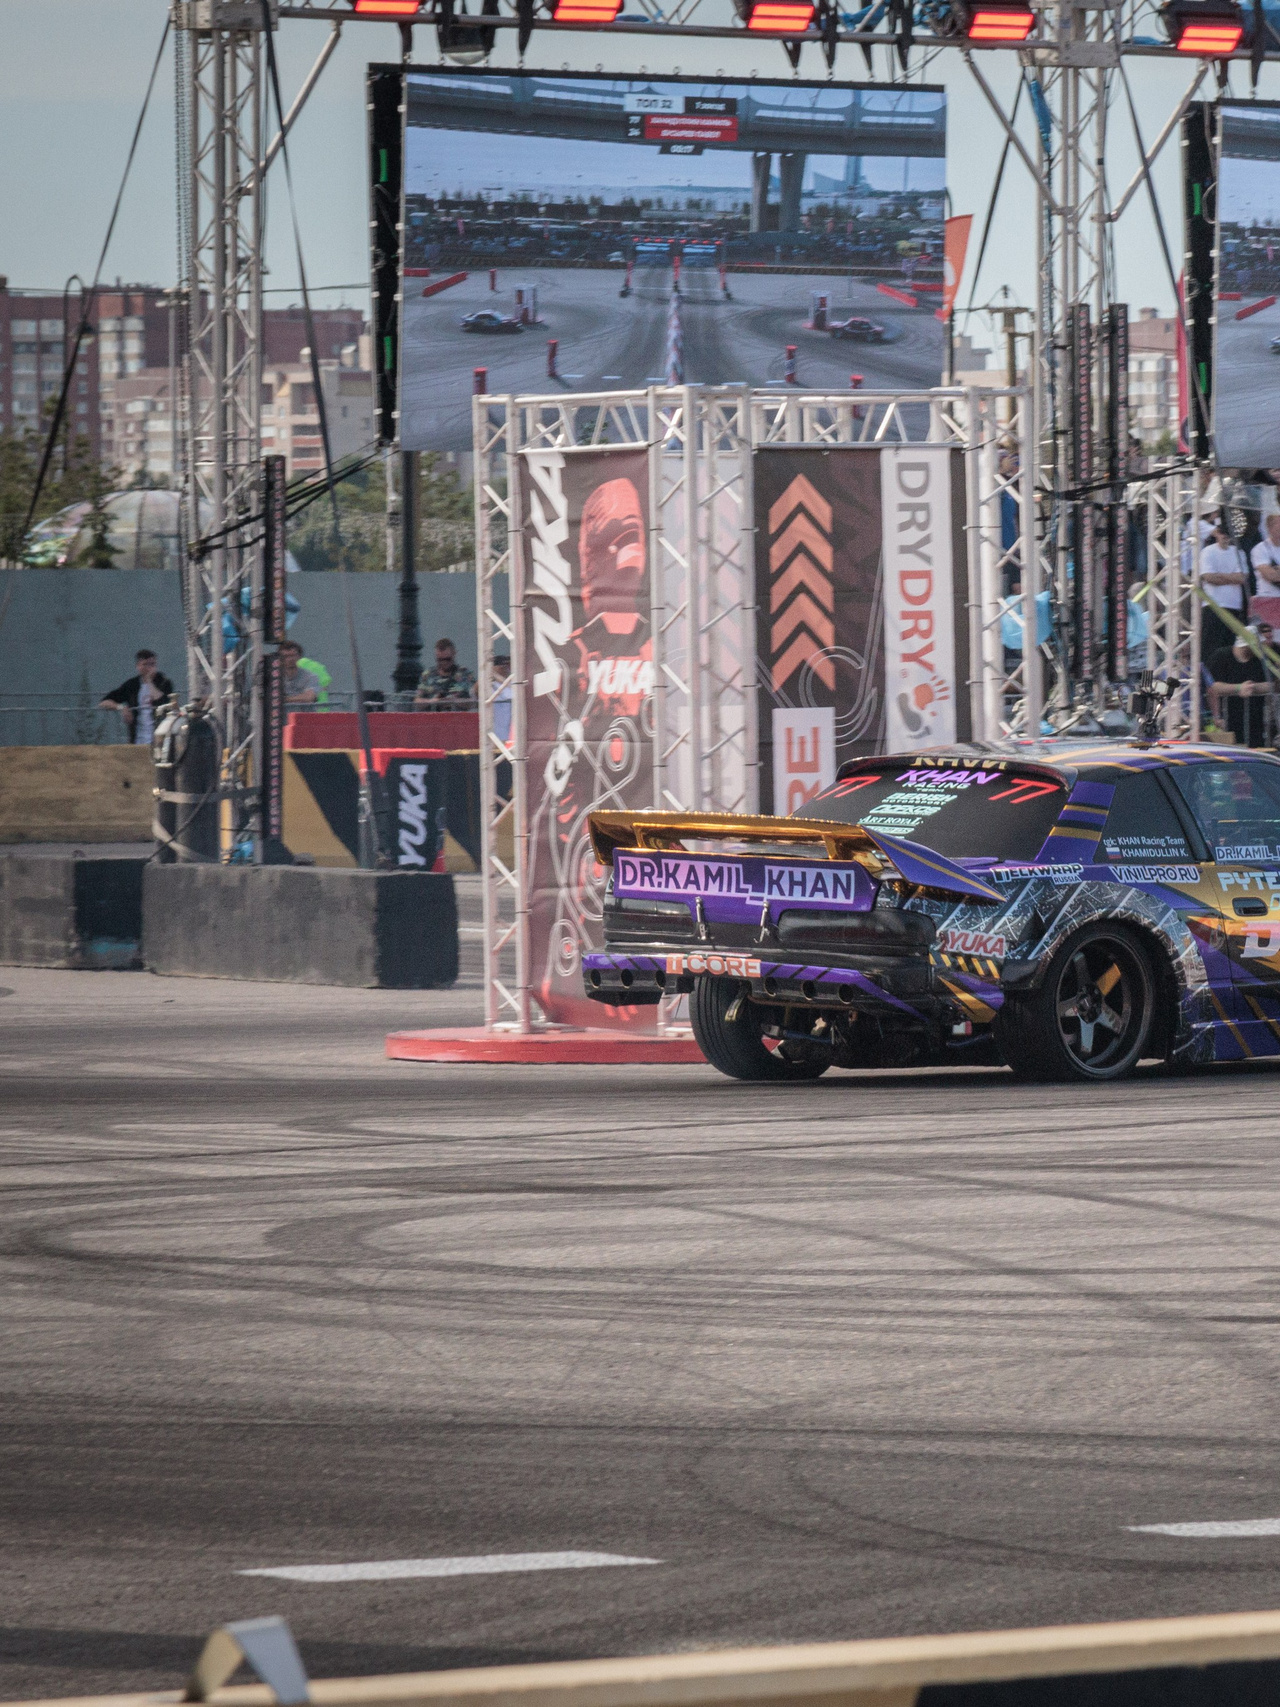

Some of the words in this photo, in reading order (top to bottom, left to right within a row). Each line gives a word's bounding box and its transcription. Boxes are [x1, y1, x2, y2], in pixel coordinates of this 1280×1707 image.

[587, 659, 657, 695] YUKA
[895, 769, 1003, 785] KHAN
[902, 781, 971, 790] RACING
[398, 764, 428, 866] YUKA
[1118, 837, 1140, 845] KHAN
[1141, 837, 1164, 847] Racing
[1122, 848, 1179, 858] KHAMIDULLIN
[1180, 848, 1189, 857] K.
[1054, 875, 1080, 883] RUSSIA
[1112, 866, 1198, 882] VINILPRO.RU
[949, 931, 1005, 957] YUKA
